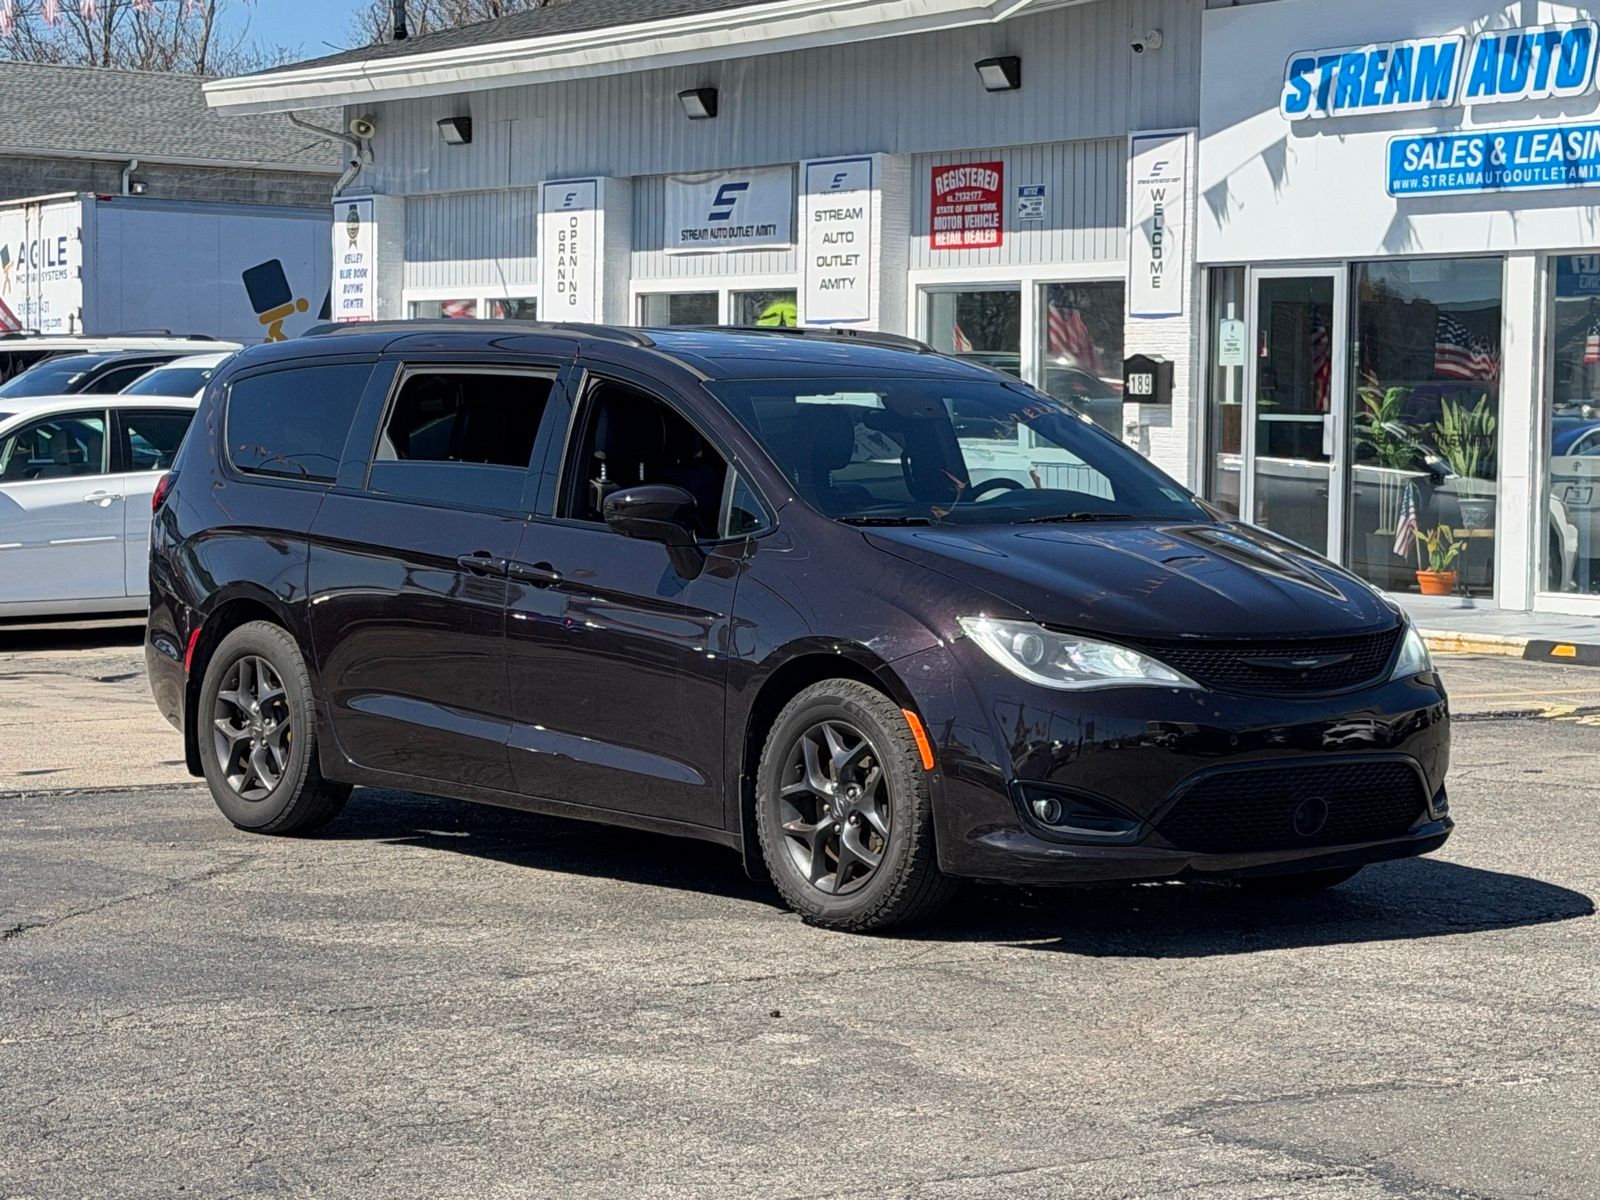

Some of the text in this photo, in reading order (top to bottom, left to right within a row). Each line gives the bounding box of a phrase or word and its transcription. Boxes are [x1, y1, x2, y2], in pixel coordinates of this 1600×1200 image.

[1284, 26, 1594, 114] STREAM AUTO
[1403, 138, 1484, 172] SALES
[1490, 136, 1507, 166] &
[935, 166, 999, 197] REGISTERED
[814, 206, 863, 222] STREAM
[936, 202, 998, 215] STATE OF NEW YORK
[934, 212, 1000, 231] MOTOR VEHICLE
[680, 223, 777, 241] STREAM AUTO OUTLET AMITY
[822, 231, 854, 245] AUTO
[935, 228, 998, 246] RETAIL DEALER
[1149, 187, 1167, 290] WELCOME
[16, 236, 68, 272] AGILE
[557, 230, 567, 294] GRAND
[568, 216, 578, 306] OPENING
[816, 254, 860, 268] OUTLET
[41, 268, 68, 282] SYSTEMS
[353, 267, 368, 279] BOOK
[819, 277, 857, 291] AMITY
[1131, 375, 1150, 393] 189
